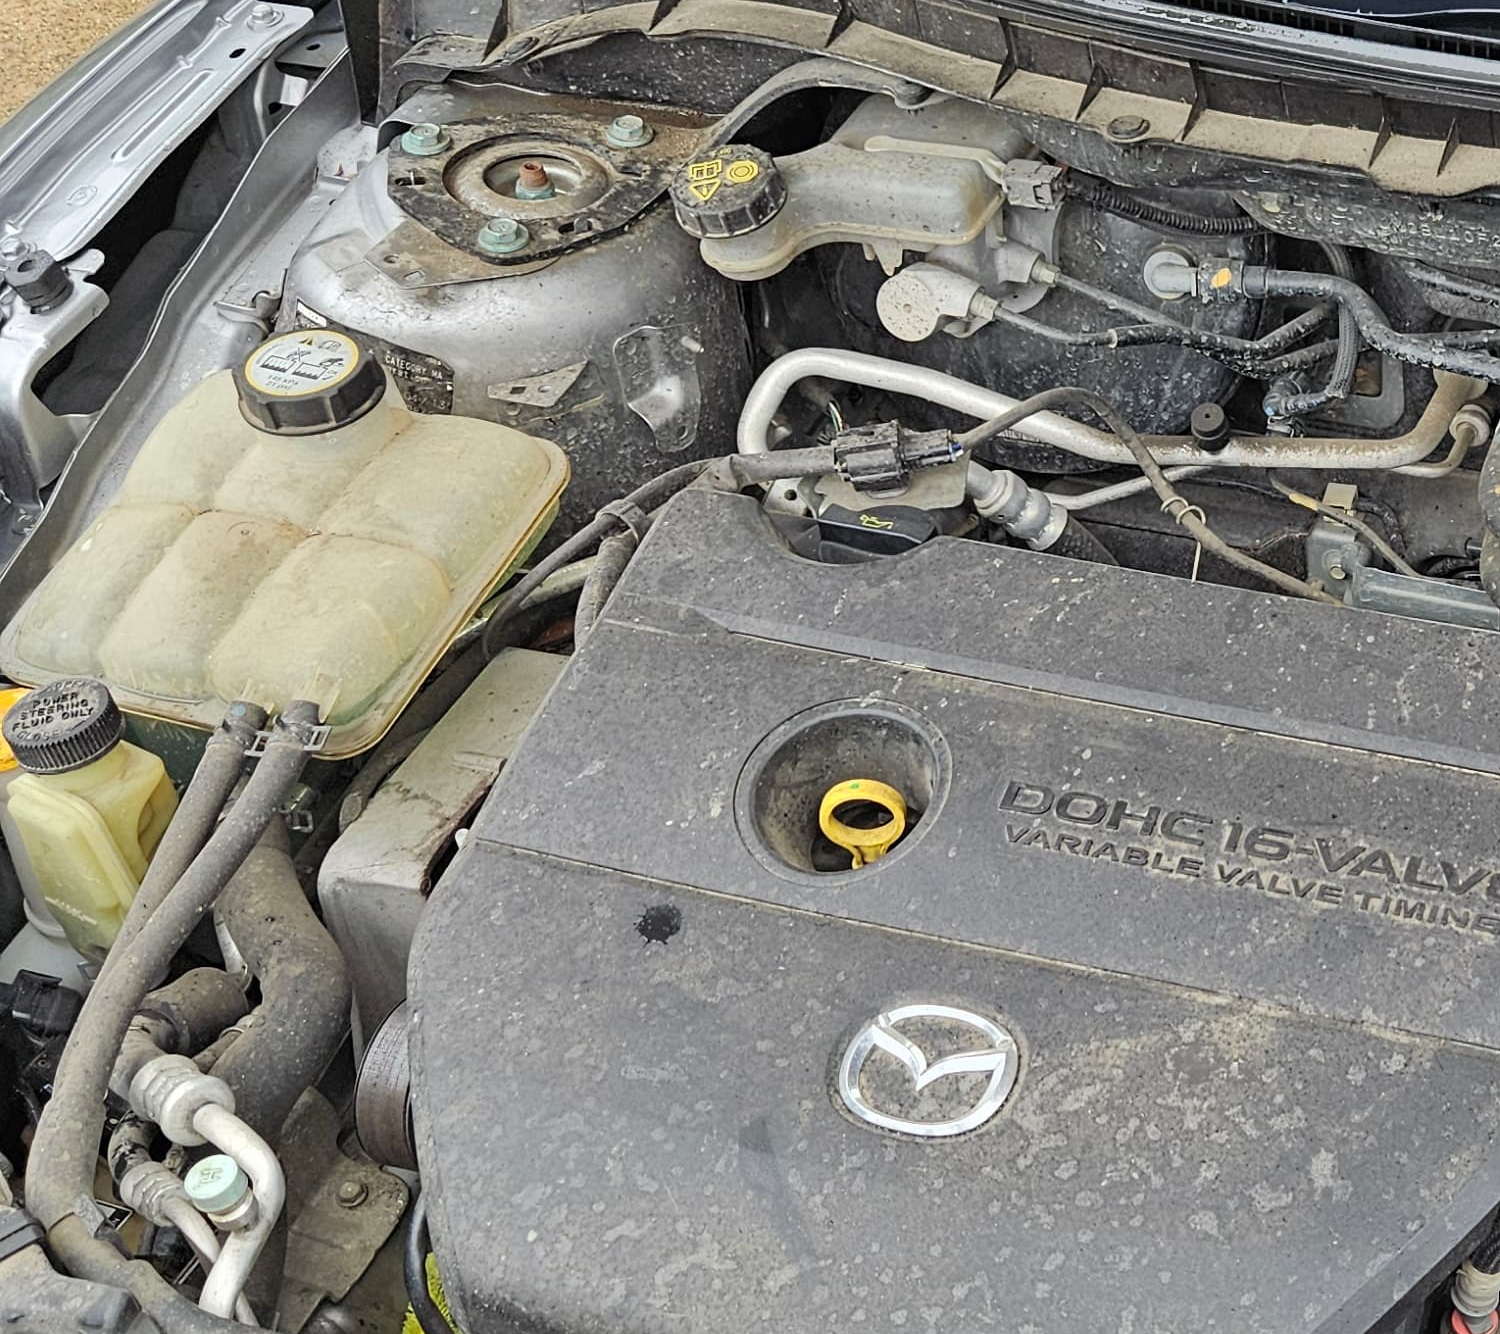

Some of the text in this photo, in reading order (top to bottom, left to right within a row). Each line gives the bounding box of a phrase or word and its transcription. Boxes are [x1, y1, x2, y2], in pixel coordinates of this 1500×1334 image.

[385, 354, 427, 374] CATEGORY
[20, 699, 88, 721] STEERING
[33, 692, 79, 709] POWER
[12, 707, 94, 732] FLUID ONLY
[998, 779, 1213, 848] DOHC
[1005, 823, 1205, 878] VARIABLE
[1217, 866, 1346, 906] VALVE
